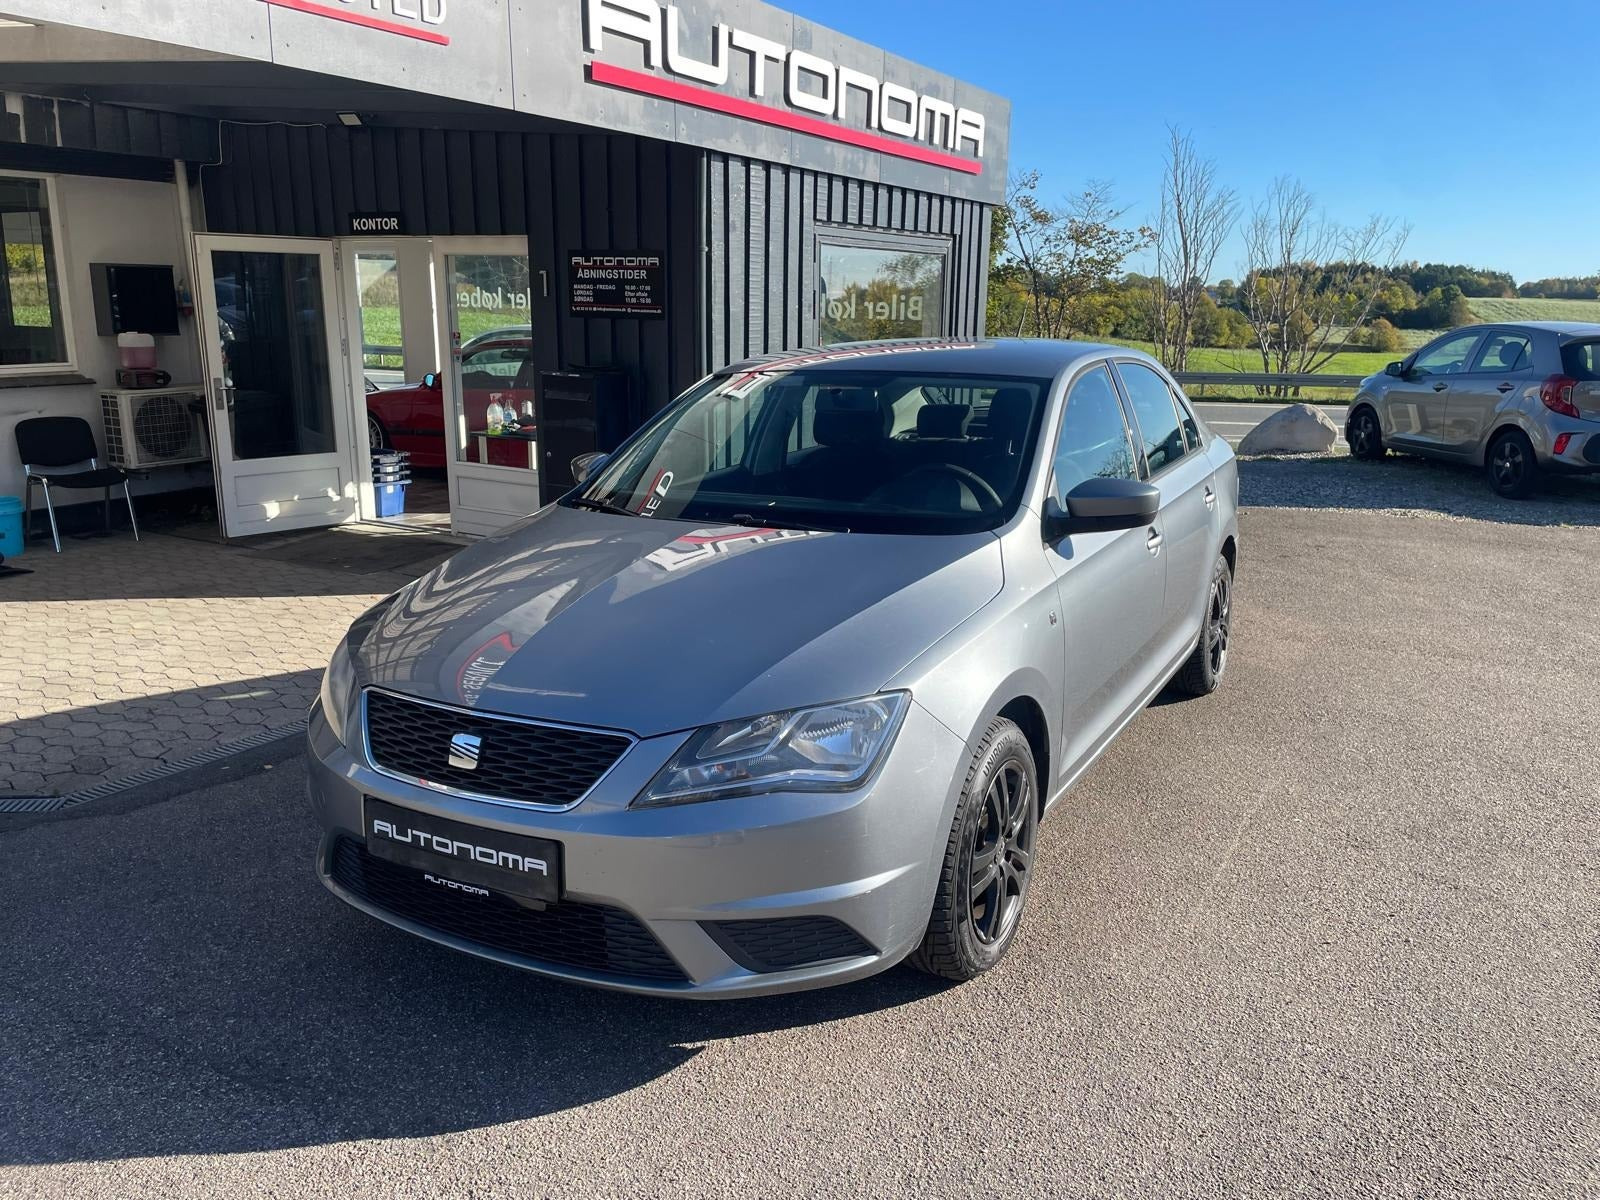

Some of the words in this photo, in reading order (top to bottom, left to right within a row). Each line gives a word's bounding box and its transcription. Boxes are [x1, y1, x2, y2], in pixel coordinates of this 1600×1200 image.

[586, 0, 985, 158] AUTONOMA
[352, 217, 399, 230] KONTOR
[571, 256, 660, 266] AUTONOMA
[373, 819, 548, 876] AUTONOMA
[424, 874, 489, 897] AUTONOMA
